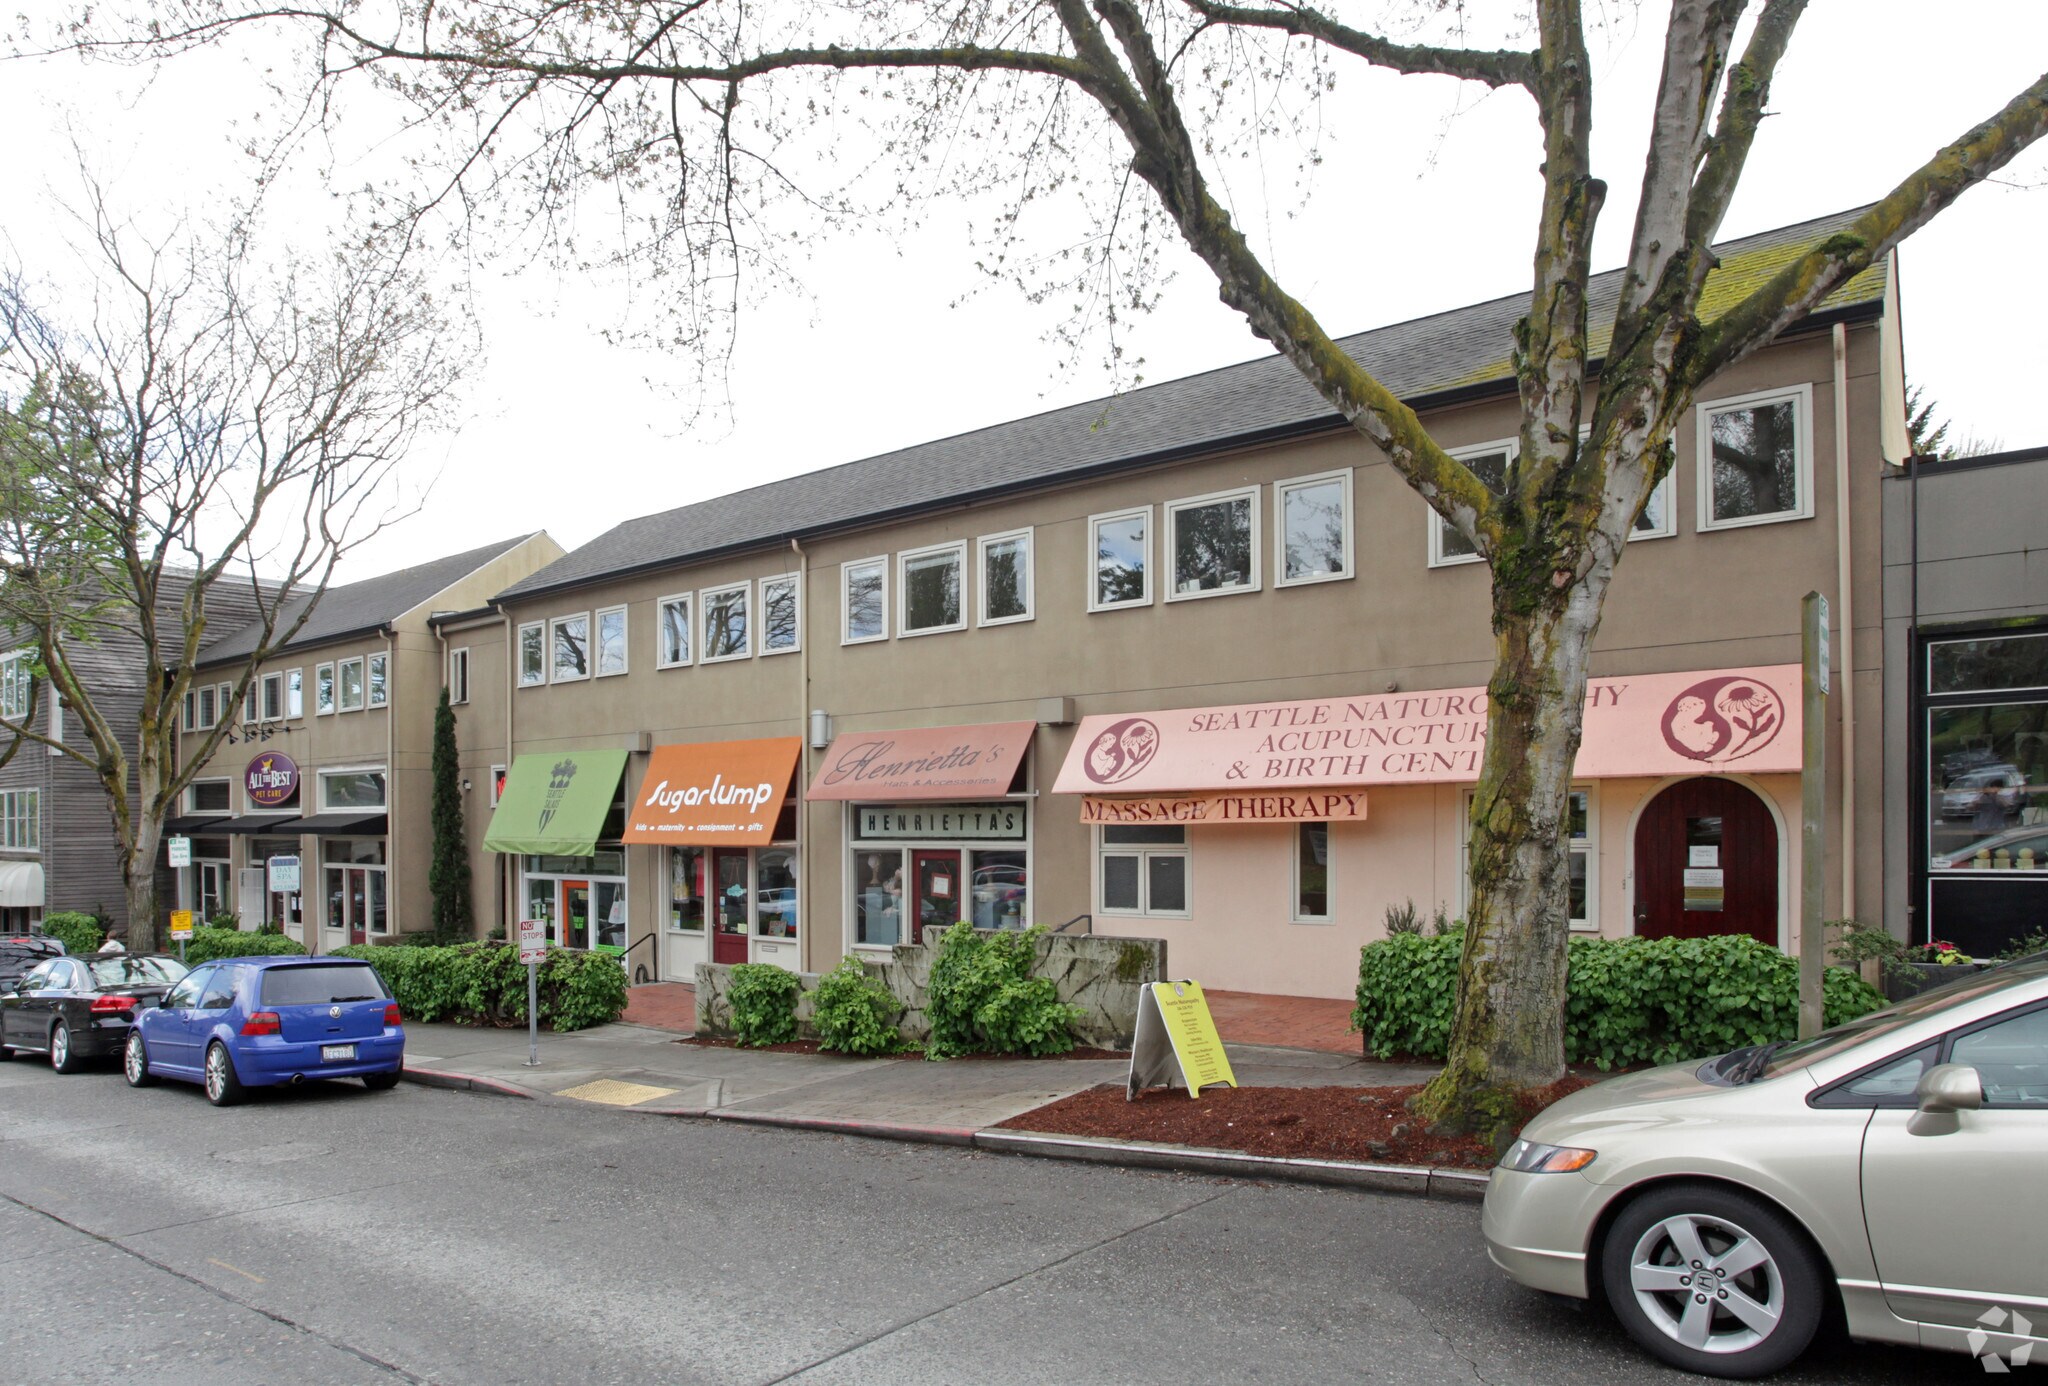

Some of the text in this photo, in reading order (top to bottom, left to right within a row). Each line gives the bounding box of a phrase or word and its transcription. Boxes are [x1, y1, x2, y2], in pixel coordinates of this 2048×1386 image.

[1188, 704, 1331, 733] SEATTLE
[1256, 721, 1488, 753] ACUPUNCTUR
[823, 741, 1005, 786] Henrietta's
[1225, 751, 1484, 780] & BIRTH CENT
[248, 771, 264, 789] ALL
[270, 770, 292, 788] BEST
[883, 777, 997, 788] Hats & Accessories
[255, 789, 282, 798] PET CARE
[645, 774, 772, 813] Sugarlump
[1083, 793, 1365, 822] MASSAGE THERAPY
[635, 822, 763, 832] kids maternity consignment gifts
[868, 809, 1014, 832] HENRIETTA'S
[522, 922, 533, 930] NO
[522, 932, 544, 940] STOPS
